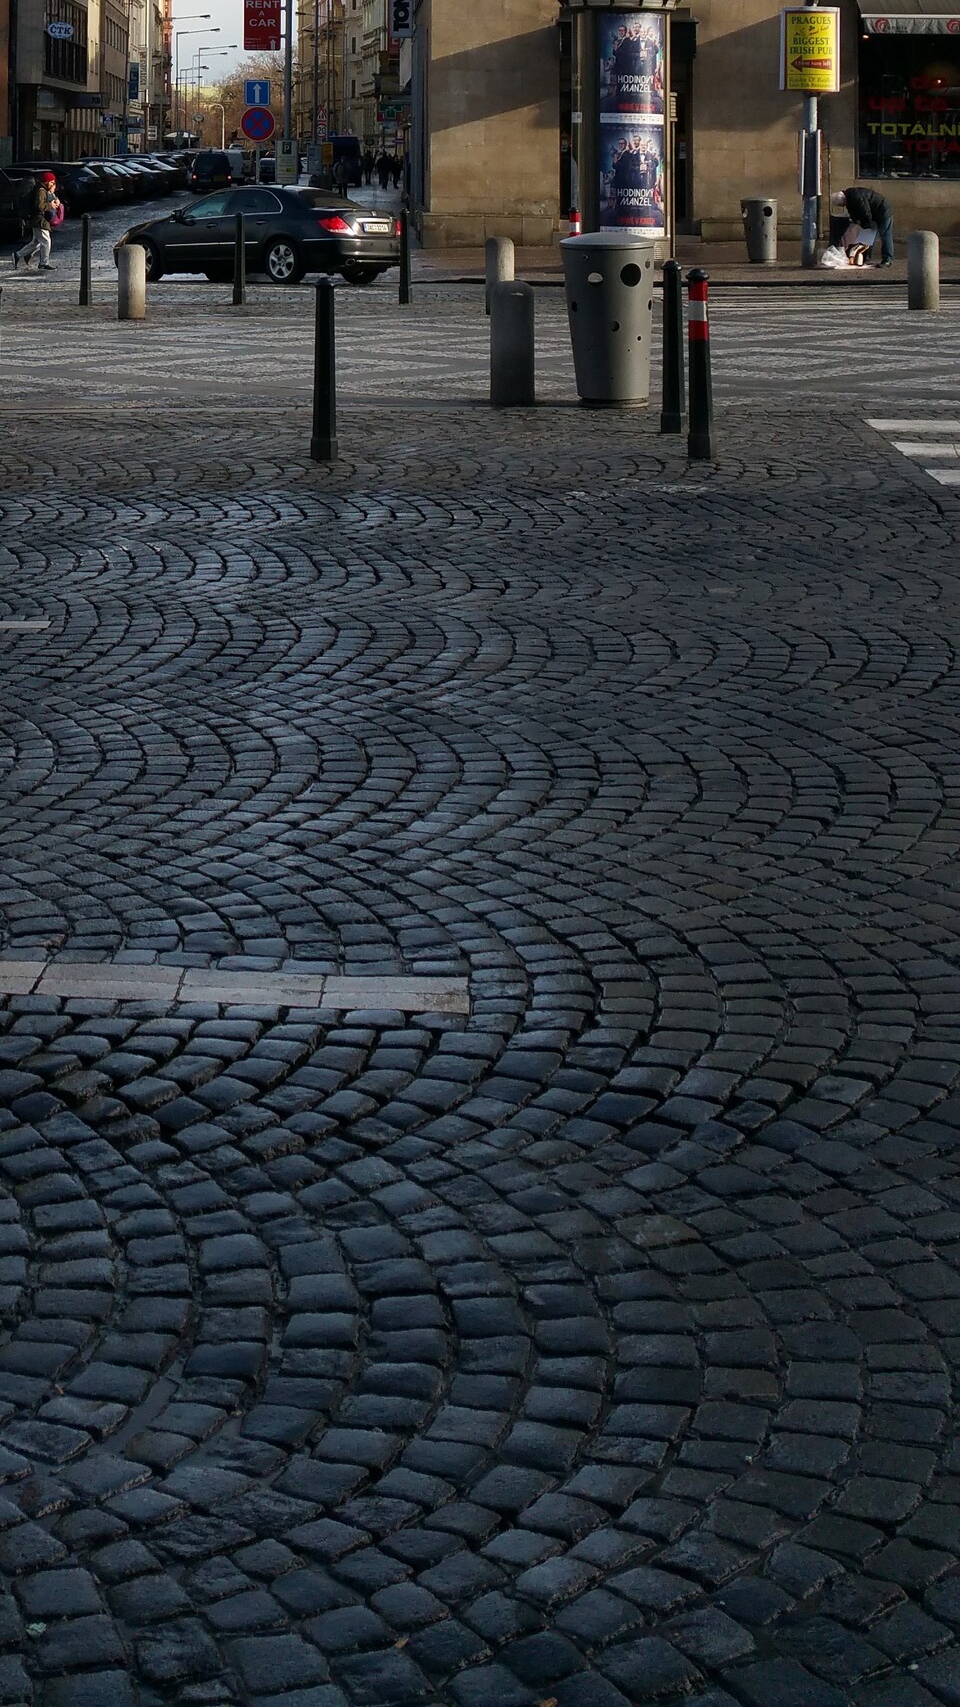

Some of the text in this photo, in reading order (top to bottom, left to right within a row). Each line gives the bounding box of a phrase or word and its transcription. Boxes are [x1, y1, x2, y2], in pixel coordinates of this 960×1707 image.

[245, 0, 280, 9] RENT
[249, 18, 276, 27] CAR
[791, 16, 831, 25] PRAGUES
[50, 25, 71, 35] ČTK
[792, 37, 830, 45] BIGGEST
[790, 46, 833, 55] IRISH PUB
